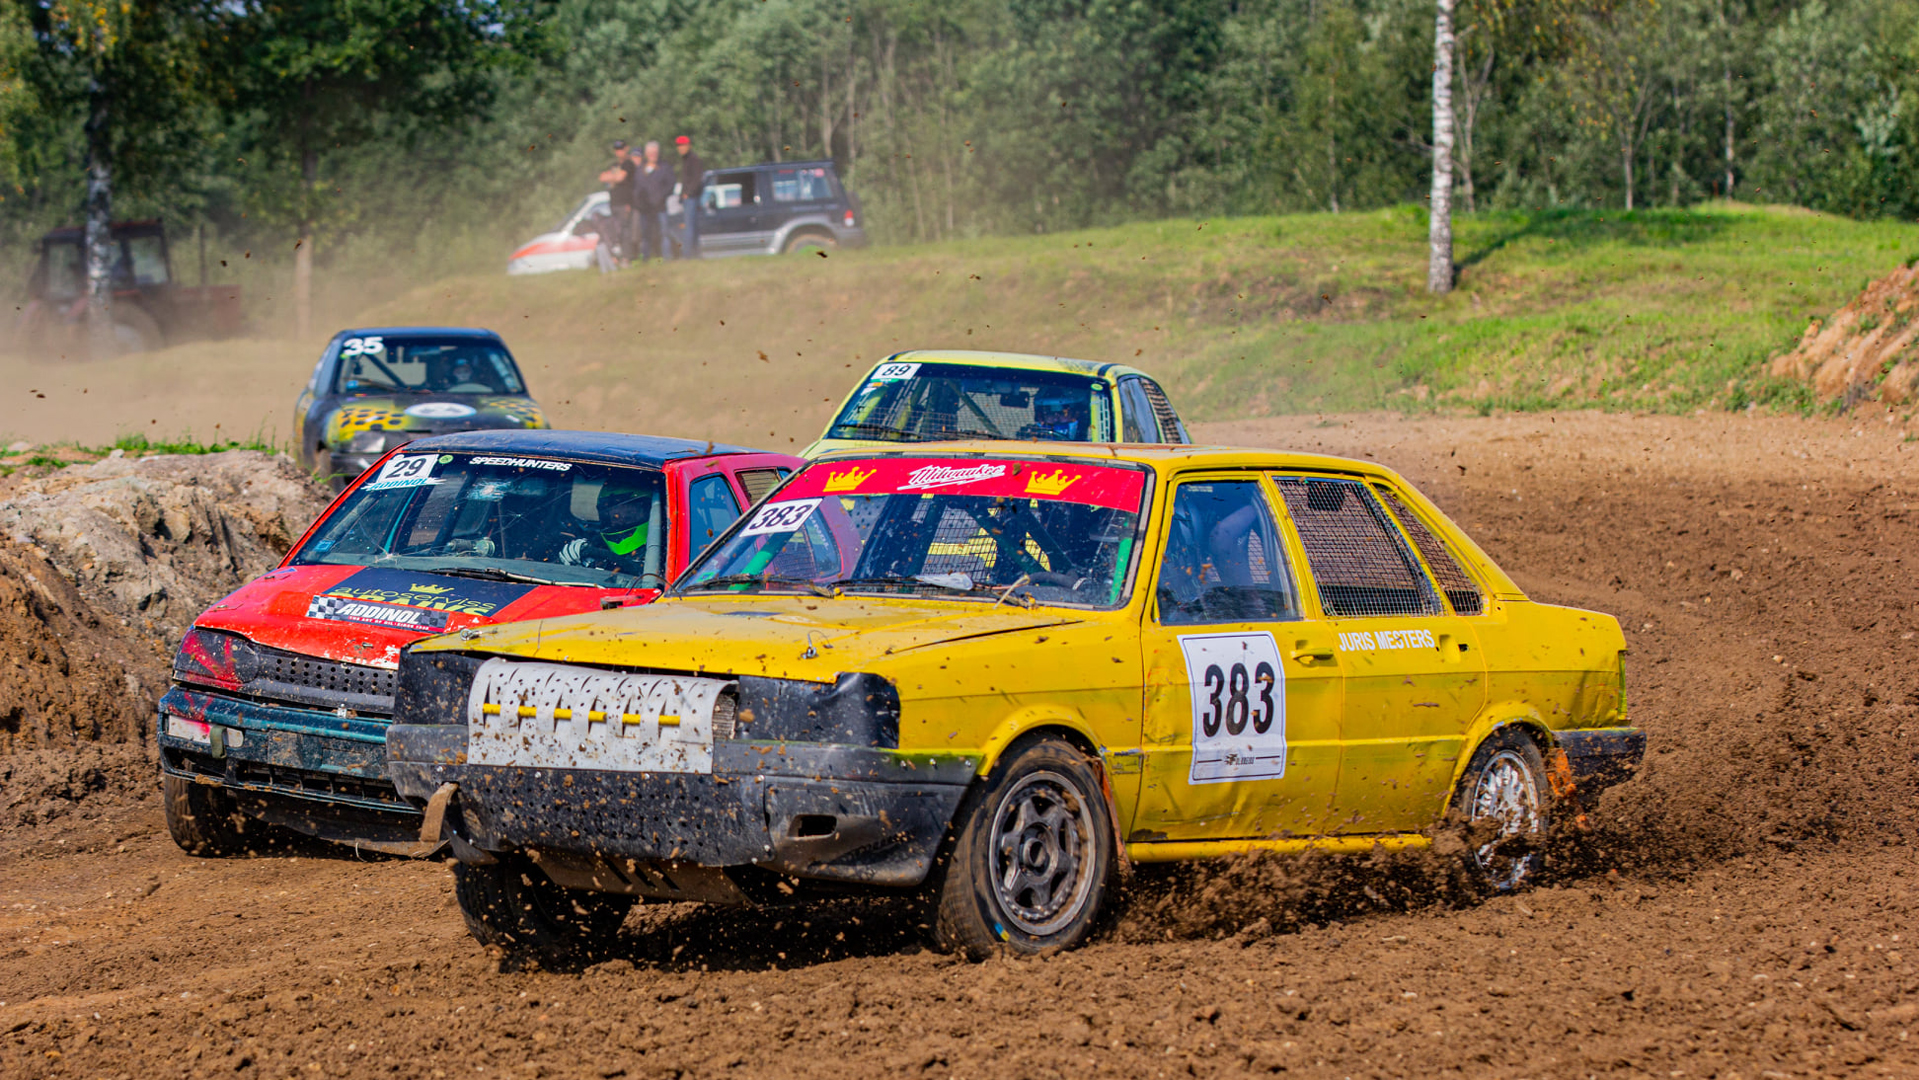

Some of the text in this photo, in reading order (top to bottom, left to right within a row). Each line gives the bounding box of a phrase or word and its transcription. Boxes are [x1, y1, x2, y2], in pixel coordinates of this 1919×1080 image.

[344, 336, 384, 356] 35
[882, 365, 911, 376] 89
[386, 458, 427, 479] 29
[468, 456, 573, 472] SPEEDHUNTERS
[908, 464, 1006, 485] Milwaukee
[749, 504, 813, 530] 383
[334, 586, 497, 610] autoserviss
[335, 603, 422, 625] ADDINOL
[1338, 629, 1435, 652] JURIS MESTERS
[1202, 661, 1275, 738] 383
